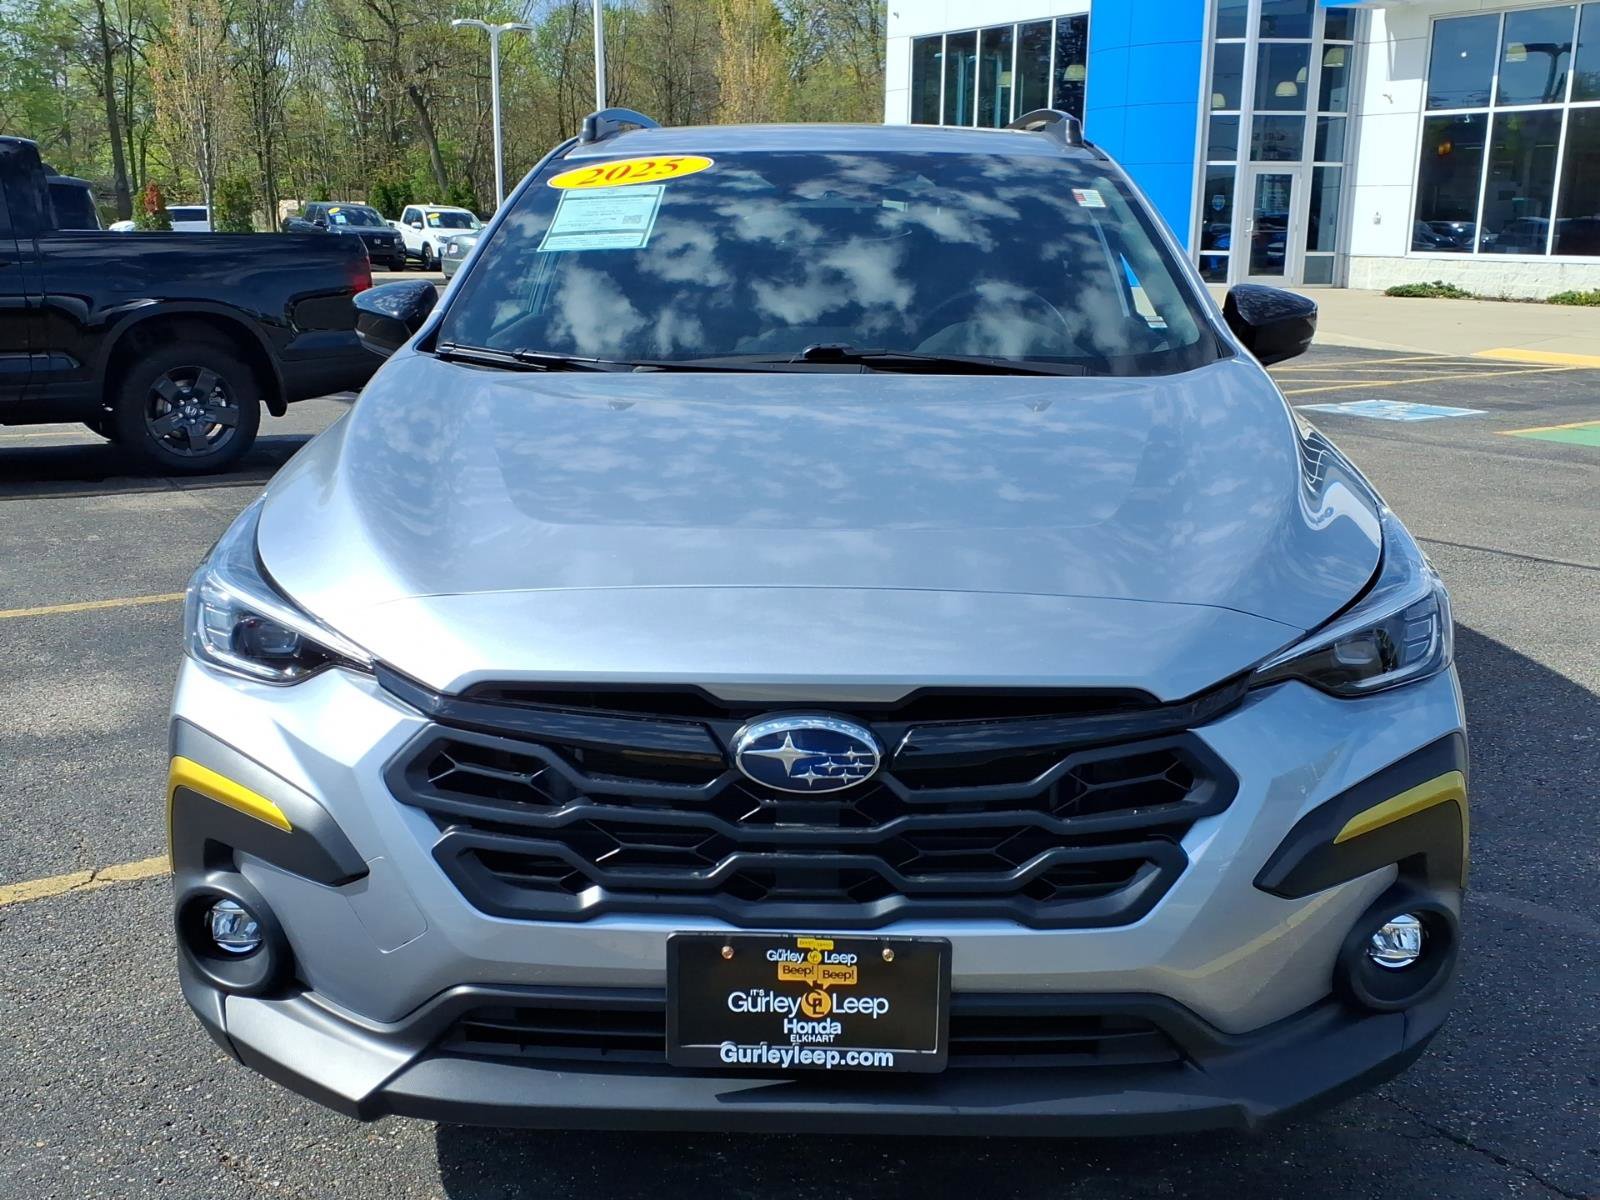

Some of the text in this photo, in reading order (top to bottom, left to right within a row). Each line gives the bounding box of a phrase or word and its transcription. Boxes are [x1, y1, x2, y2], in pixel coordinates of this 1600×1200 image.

[576, 158, 685, 185] 2025
[824, 951, 858, 966] Leep
[782, 965, 814, 977] Beep!
[822, 969, 854, 981] Beep!
[728, 991, 801, 1018] Gurley
[832, 993, 889, 1019] Leep
[783, 1017, 842, 1034] Honda
[790, 1034, 835, 1043] ELKHART
[720, 1044, 894, 1069] Gurleyleep.com
